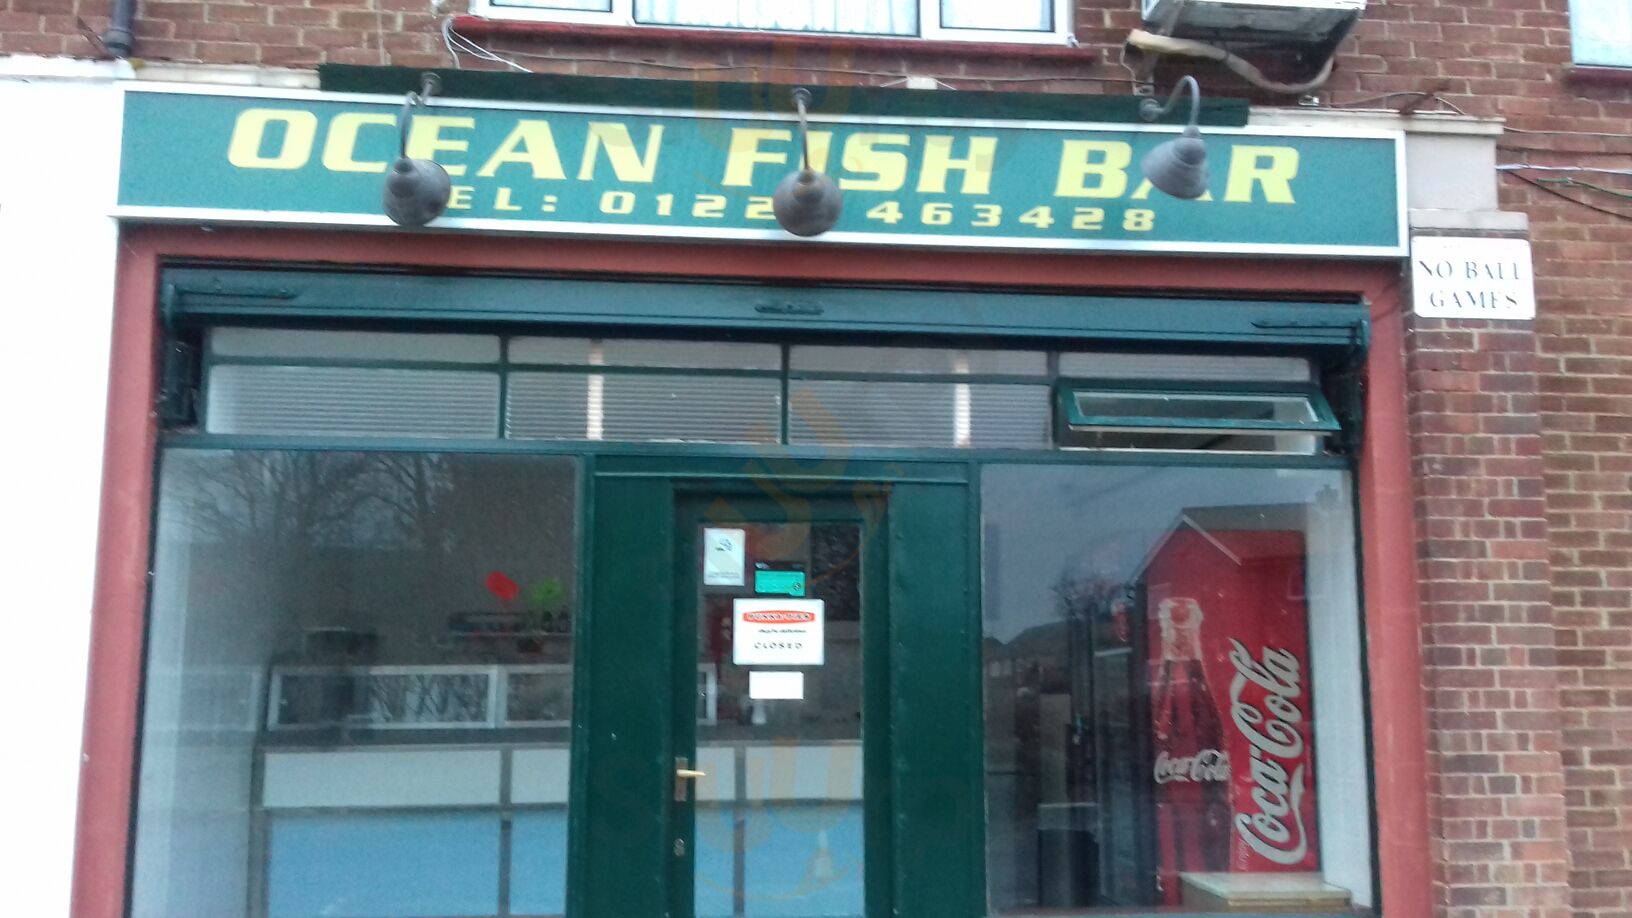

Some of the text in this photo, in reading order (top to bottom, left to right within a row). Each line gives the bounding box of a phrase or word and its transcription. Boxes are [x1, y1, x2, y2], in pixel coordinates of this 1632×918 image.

[228, 107, 1300, 204] OCEAN FISH BR
[865, 201, 1156, 232] 463428
[1419, 260, 1520, 280] NO BALL
[1430, 290, 1518, 309] GAMES
[1229, 638, 1308, 865] Coca-Cola
